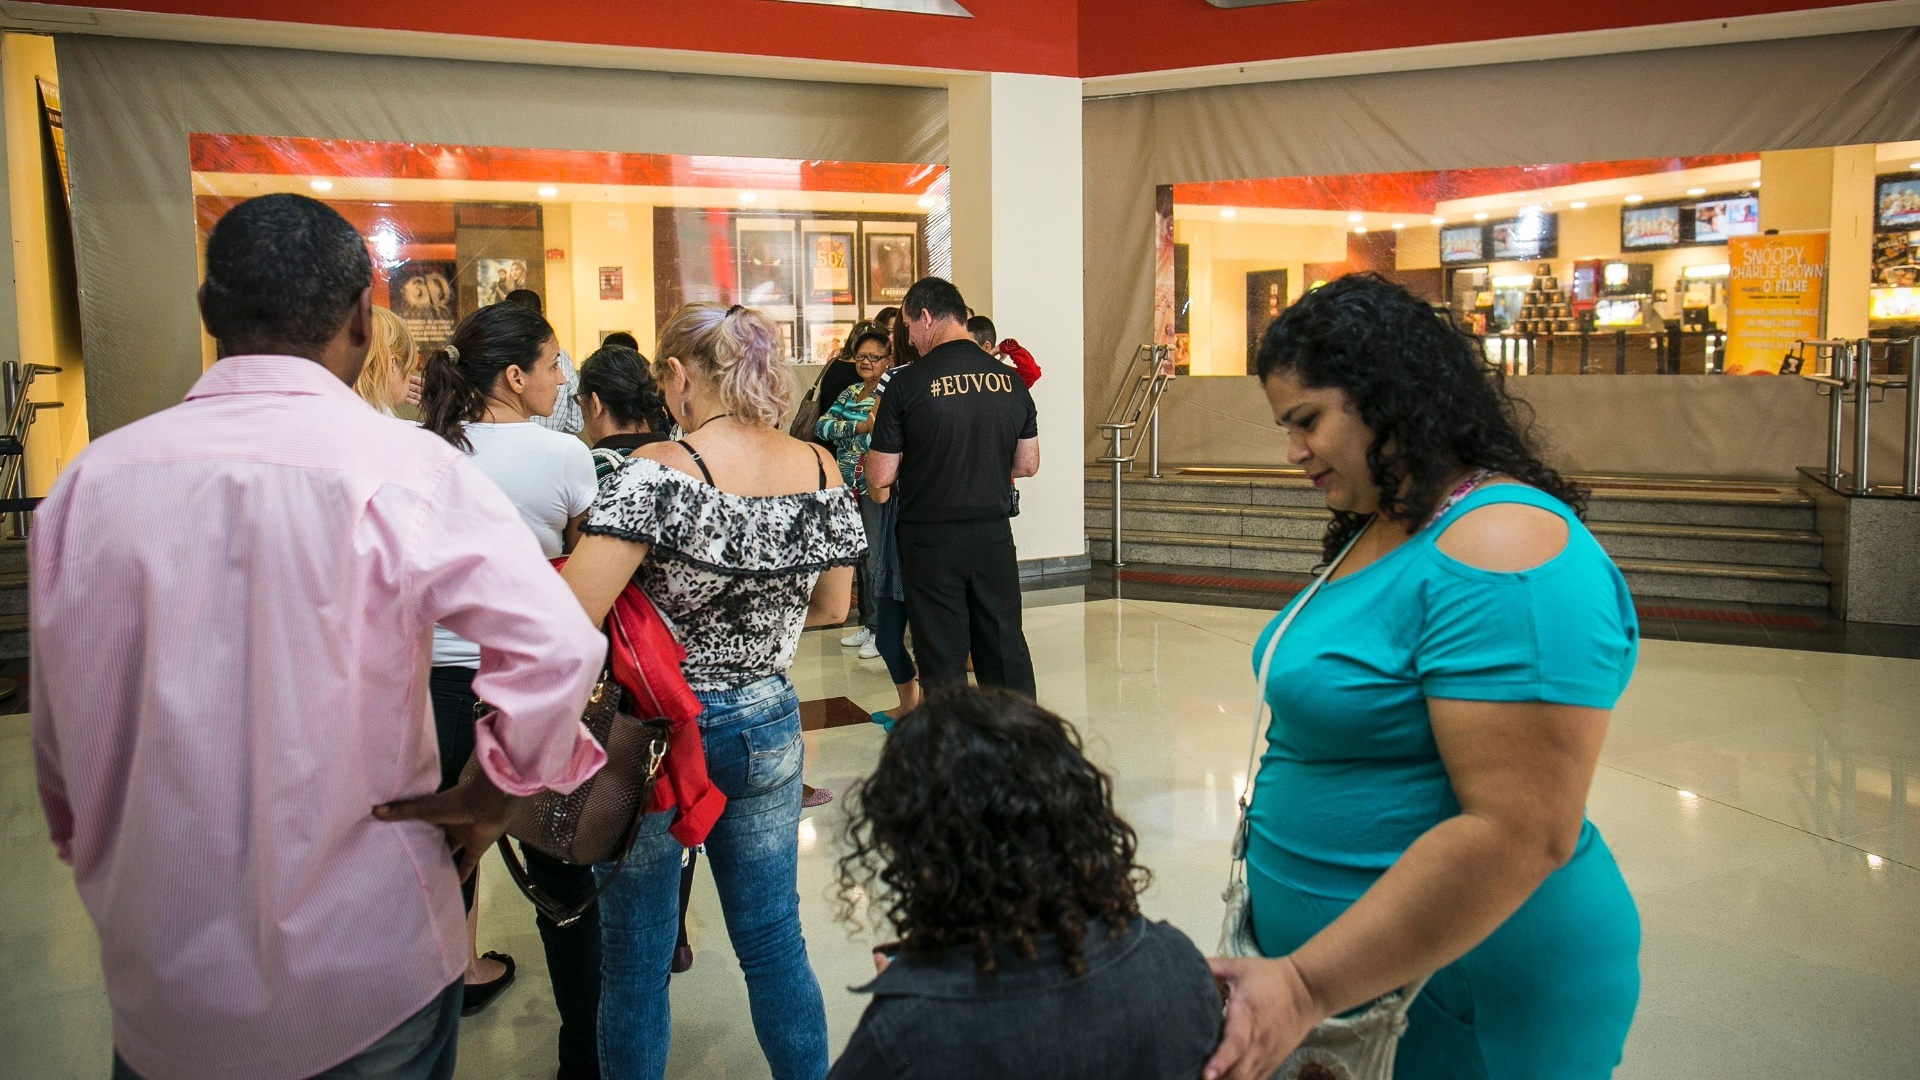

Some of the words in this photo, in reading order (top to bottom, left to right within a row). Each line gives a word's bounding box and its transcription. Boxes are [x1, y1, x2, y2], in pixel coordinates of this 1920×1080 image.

[815, 251, 846, 268] 50%
[1743, 247, 1804, 266] SNOOPY
[1731, 265, 1777, 280] CHARLIE
[1780, 264, 1824, 278] BROWN
[1763, 280, 1771, 293] O
[1775, 280, 1808, 293] FILME
[930, 373, 1013, 397] #EUVOU
